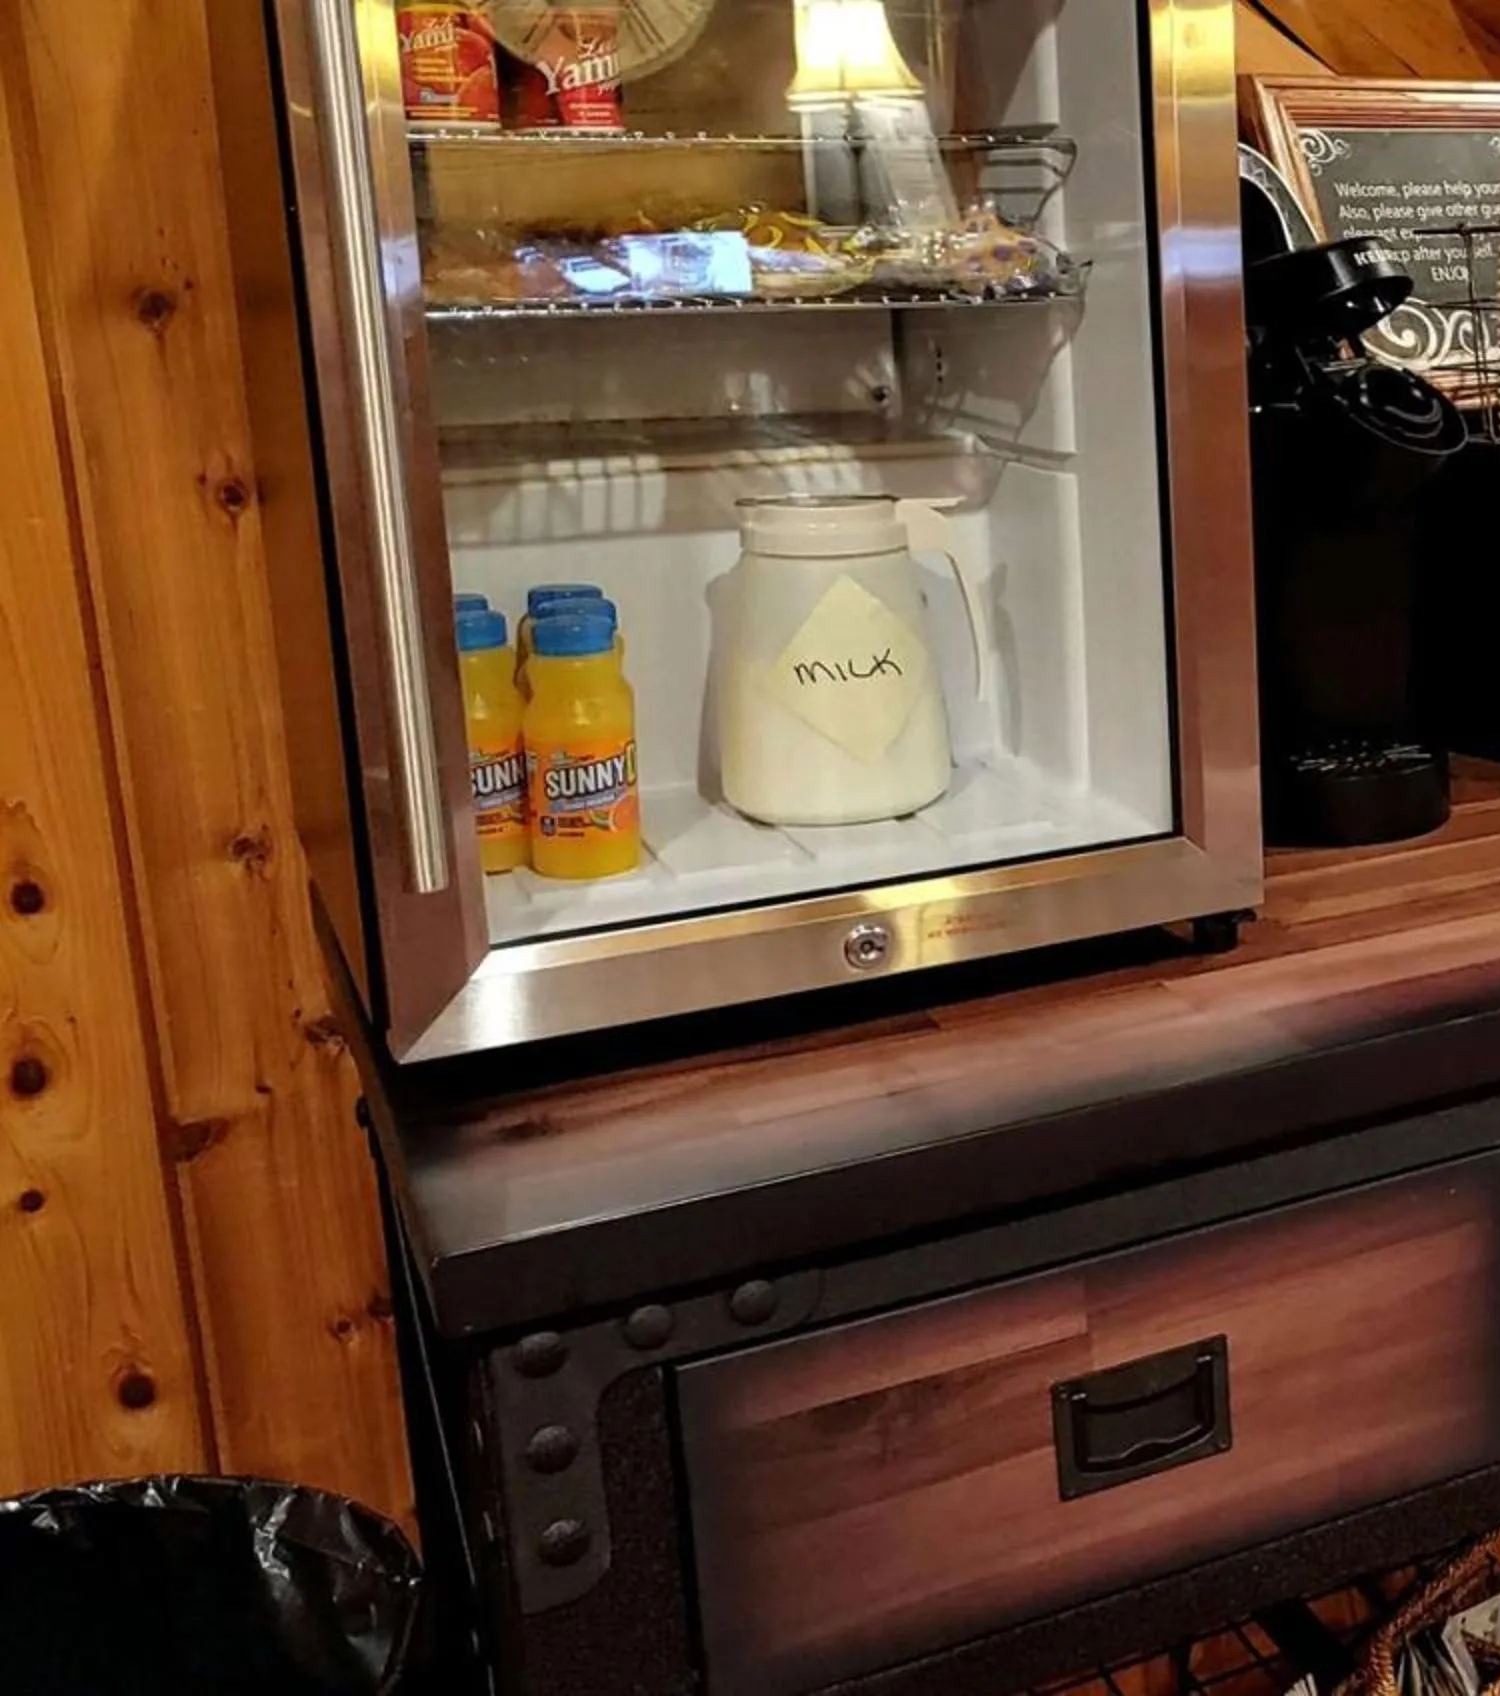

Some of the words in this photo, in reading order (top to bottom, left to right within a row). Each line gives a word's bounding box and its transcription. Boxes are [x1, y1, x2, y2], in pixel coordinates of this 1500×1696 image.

[1402, 181, 1441, 200] please
[1444, 180, 1472, 199] help
[1372, 203, 1414, 222] please
[1416, 206, 1443, 221] give
[1446, 203, 1479, 218] other
